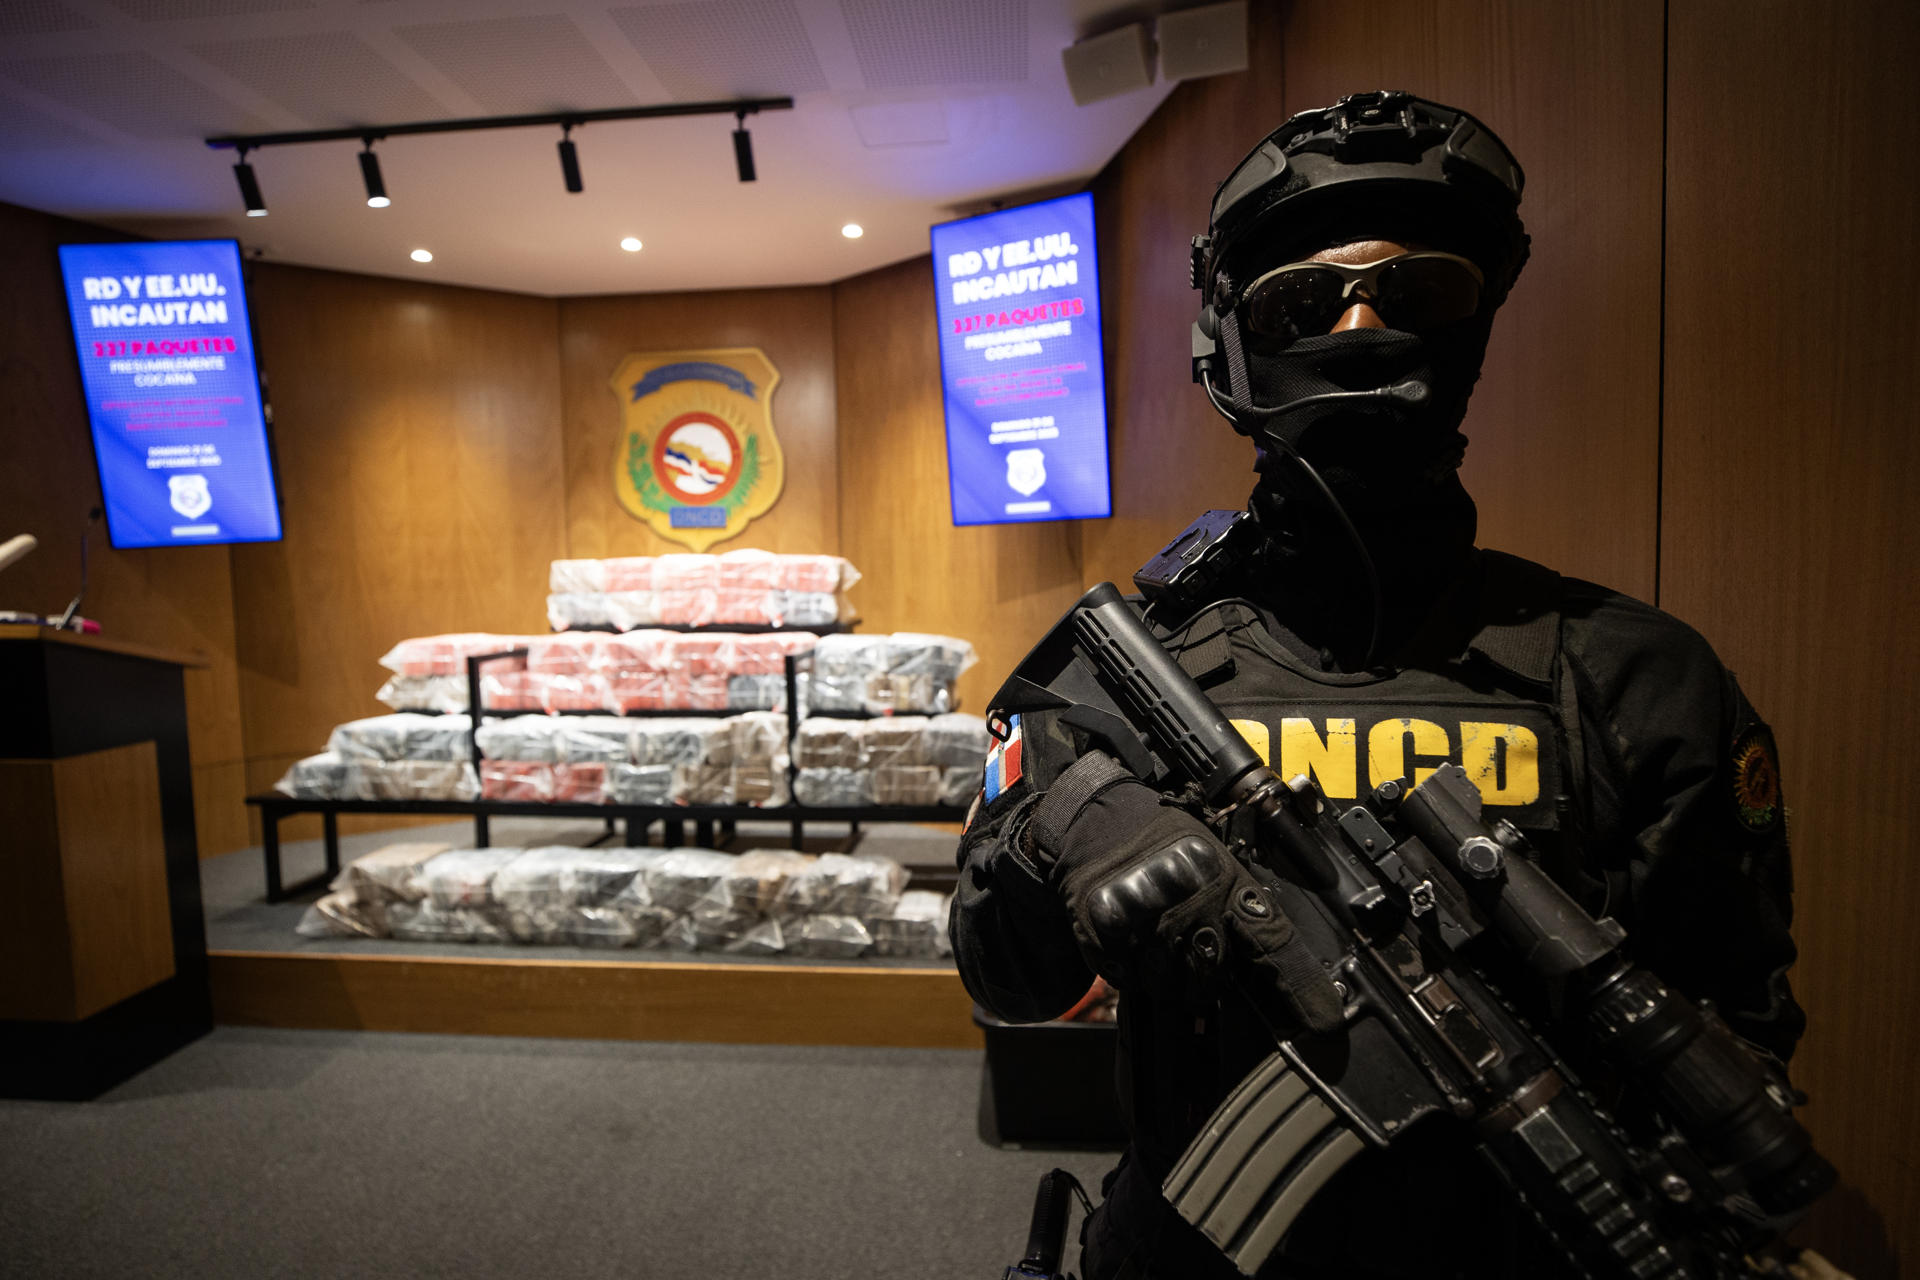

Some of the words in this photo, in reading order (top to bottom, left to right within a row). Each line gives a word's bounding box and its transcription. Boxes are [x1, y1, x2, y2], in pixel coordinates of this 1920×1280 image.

[949, 251, 983, 278] RD
[982, 245, 1001, 271] Y
[83, 276, 122, 300] RD
[122, 275, 142, 299] Y
[145, 273, 226, 298] EE.UU.
[952, 260, 1078, 305] INCAUTAN
[91, 300, 228, 328] INCAUTAN
[985, 297, 1084, 328] PAQUETES
[131, 337, 236, 356] PAQUETES
